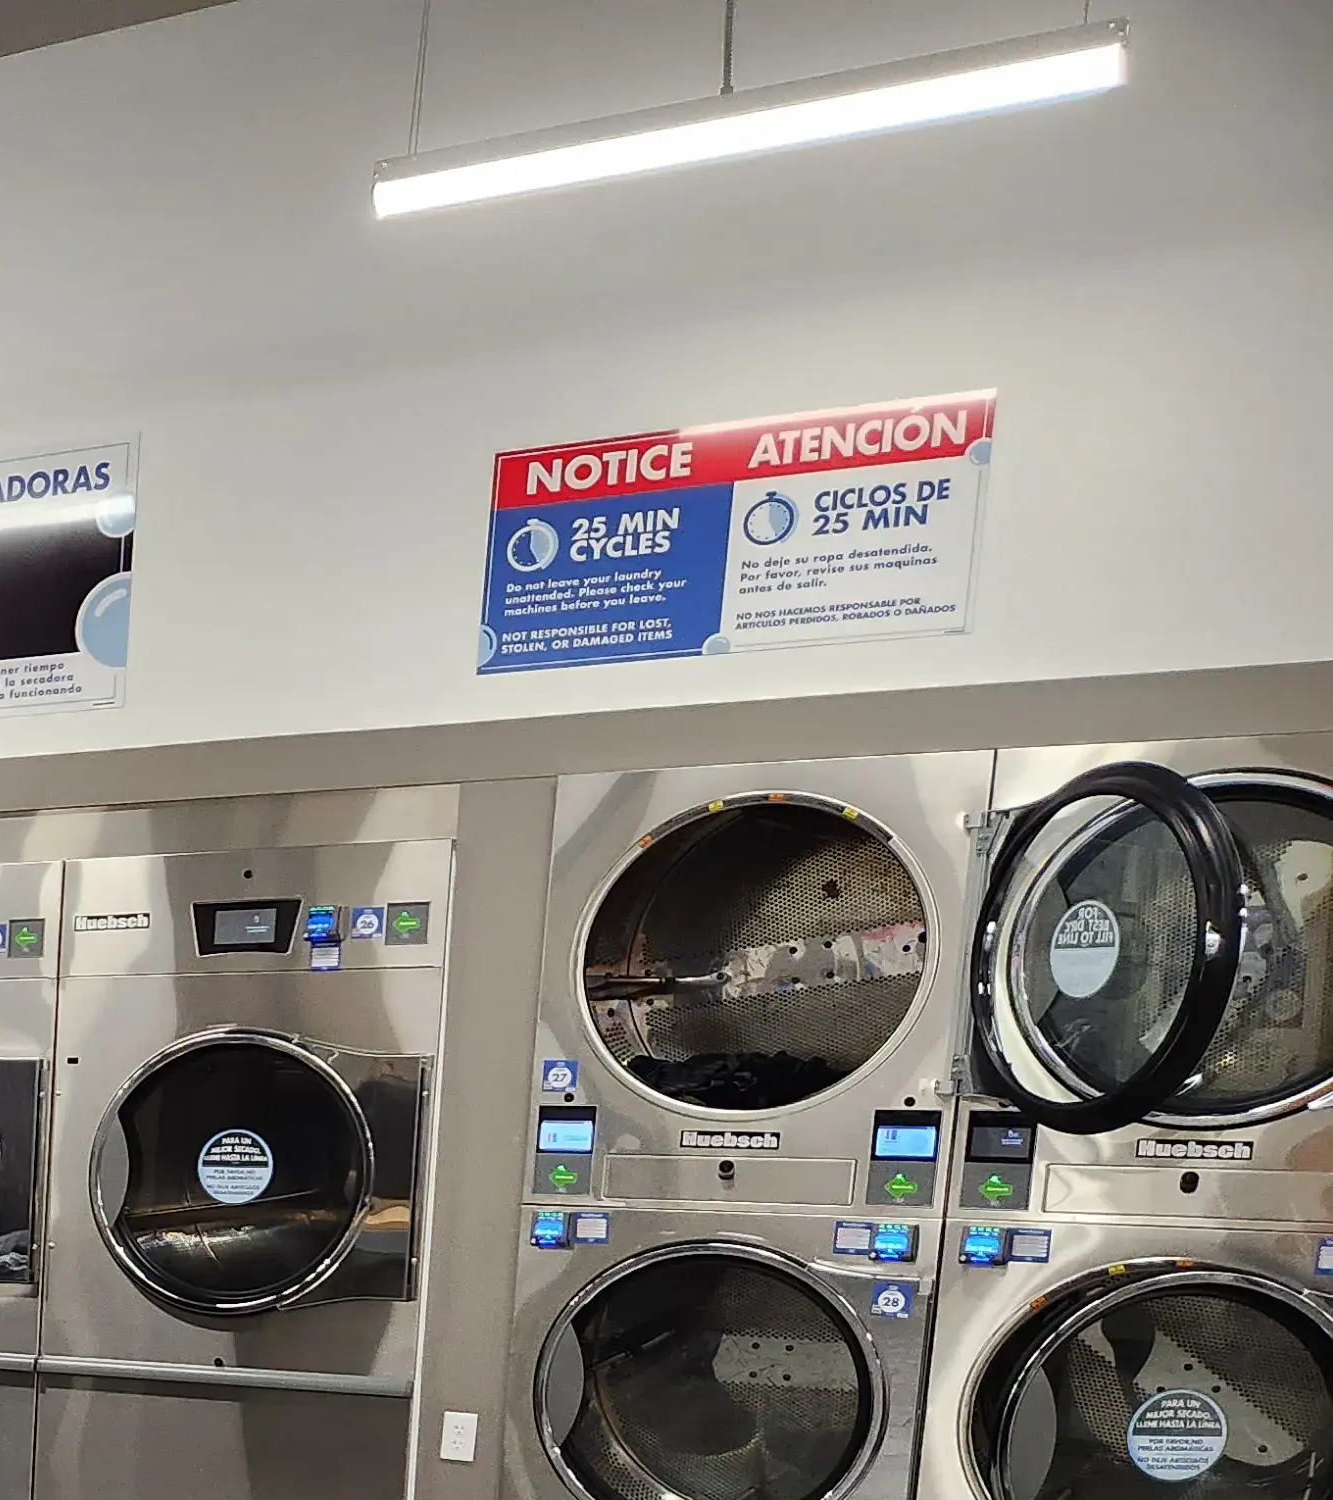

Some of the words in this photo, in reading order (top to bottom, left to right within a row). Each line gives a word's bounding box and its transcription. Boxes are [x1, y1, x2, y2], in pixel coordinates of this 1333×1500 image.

[525, 441, 692, 495] NOTICE
[748, 405, 967, 468] ATENCIÓN
[814, 481, 908, 513] CICLOS
[916, 478, 951, 503] DE
[570, 516, 607, 541] 25
[617, 507, 681, 535] MIN
[811, 512, 849, 536] 25
[862, 503, 929, 531] MIN
[570, 530, 671, 562] CYCLES
[741, 560, 760, 570] No
[764, 556, 790, 569] deje
[795, 556, 809, 565] su
[813, 552, 844, 564] ropa
[848, 543, 933, 559] desatendida.
[506, 582, 523, 593] Do
[525, 581, 545, 592] not
[547, 578, 580, 589] leave
[583, 574, 611, 586] your
[614, 568, 662, 581] laundry
[740, 572, 761, 583] Por
[765, 568, 802, 581] favor,
[807, 563, 845, 576] revise
[849, 562, 869, 572] sus
[874, 556, 938, 571] maquinas
[505, 591, 576, 605] unattended.
[578, 585, 617, 598] Please
[620, 581, 654, 593] check
[658, 579, 687, 591] your
[738, 584, 773, 595] antes
[776, 580, 793, 591] de
[797, 578, 827, 590] salir.
[504, 604, 558, 617] machines
[560, 599, 600, 611] before
[603, 597, 626, 609] you
[629, 593, 667, 605] leave.
[736, 612, 753, 621] NO
[754, 610, 776, 619] NOS
[779, 604, 827, 616] HACEMOS
[829, 599, 897, 612] RESPONSABLE
[899, 597, 921, 606] POR
[842, 609, 890, 621] ROBADOS
[893, 608, 902, 616] O
[502, 631, 528, 643] NOT
[531, 624, 608, 640] RESPONSIBLE
[612, 621, 636, 632] FOR
[639, 617, 672, 630] LOST,
[501, 642, 548, 654] STOLEN,
[551, 639, 570, 649] OR
[573, 633, 634, 648] DAMAGED
[637, 629, 673, 641] ITEMS
[23, 662, 65, 674] tiempo
[5, 676, 16, 687] la
[20, 673, 74, 686] secadora
[9, 685, 82, 700] funcionando
[76, 913, 149, 931] Huebsch
[360, 919, 374, 929] 26
[552, 1073, 567, 1082] 27
[682, 1131, 778, 1148] Huebsch
[1137, 1139, 1251, 1159] Huebsch
[882, 1296, 900, 1307] 28
[1161, 1399, 1185, 1409] PARA
[1159, 1419, 1185, 1428] HASTA
[1186, 1420, 1198, 1428] LA
